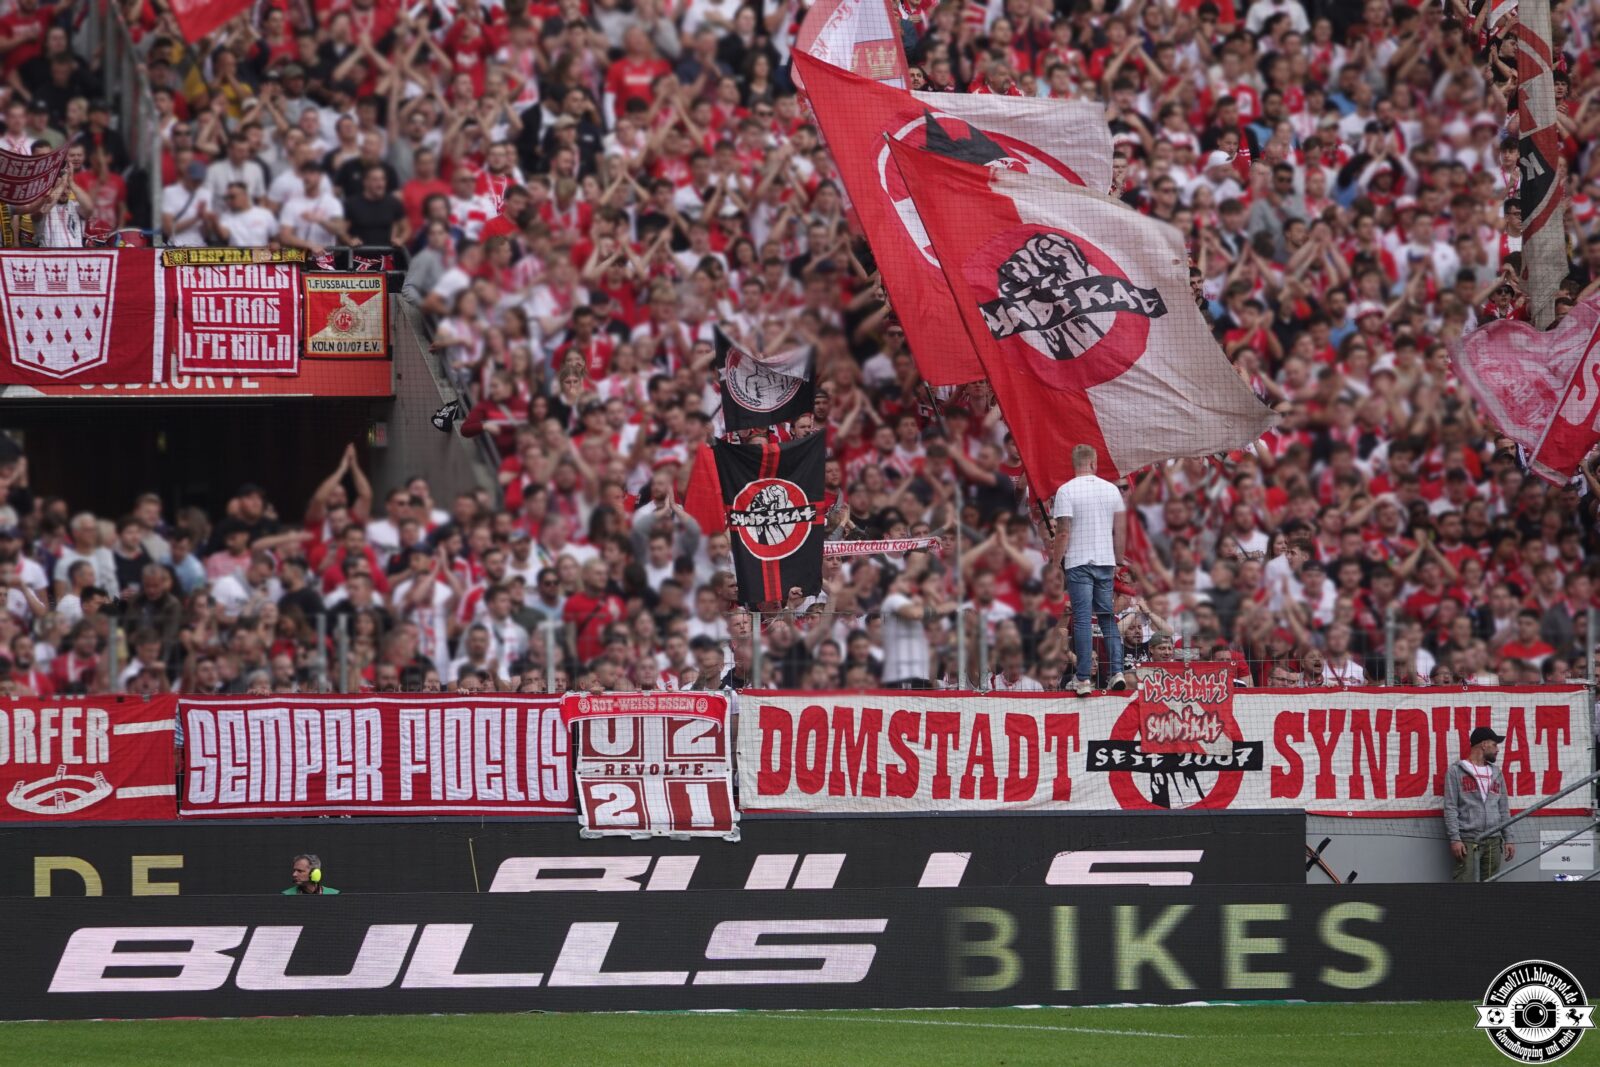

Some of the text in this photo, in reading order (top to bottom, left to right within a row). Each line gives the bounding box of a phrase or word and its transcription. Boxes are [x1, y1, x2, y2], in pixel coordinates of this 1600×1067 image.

[191, 296, 280, 324] ULTRAS
[230, 331, 292, 361] KÖLN
[658, 698, 696, 712] ESSEN
[188, 707, 569, 804] SEMPER FIDELIS
[757, 705, 1080, 802] DOMSTADT
[47, 901, 1393, 992] BULLS BIKES
